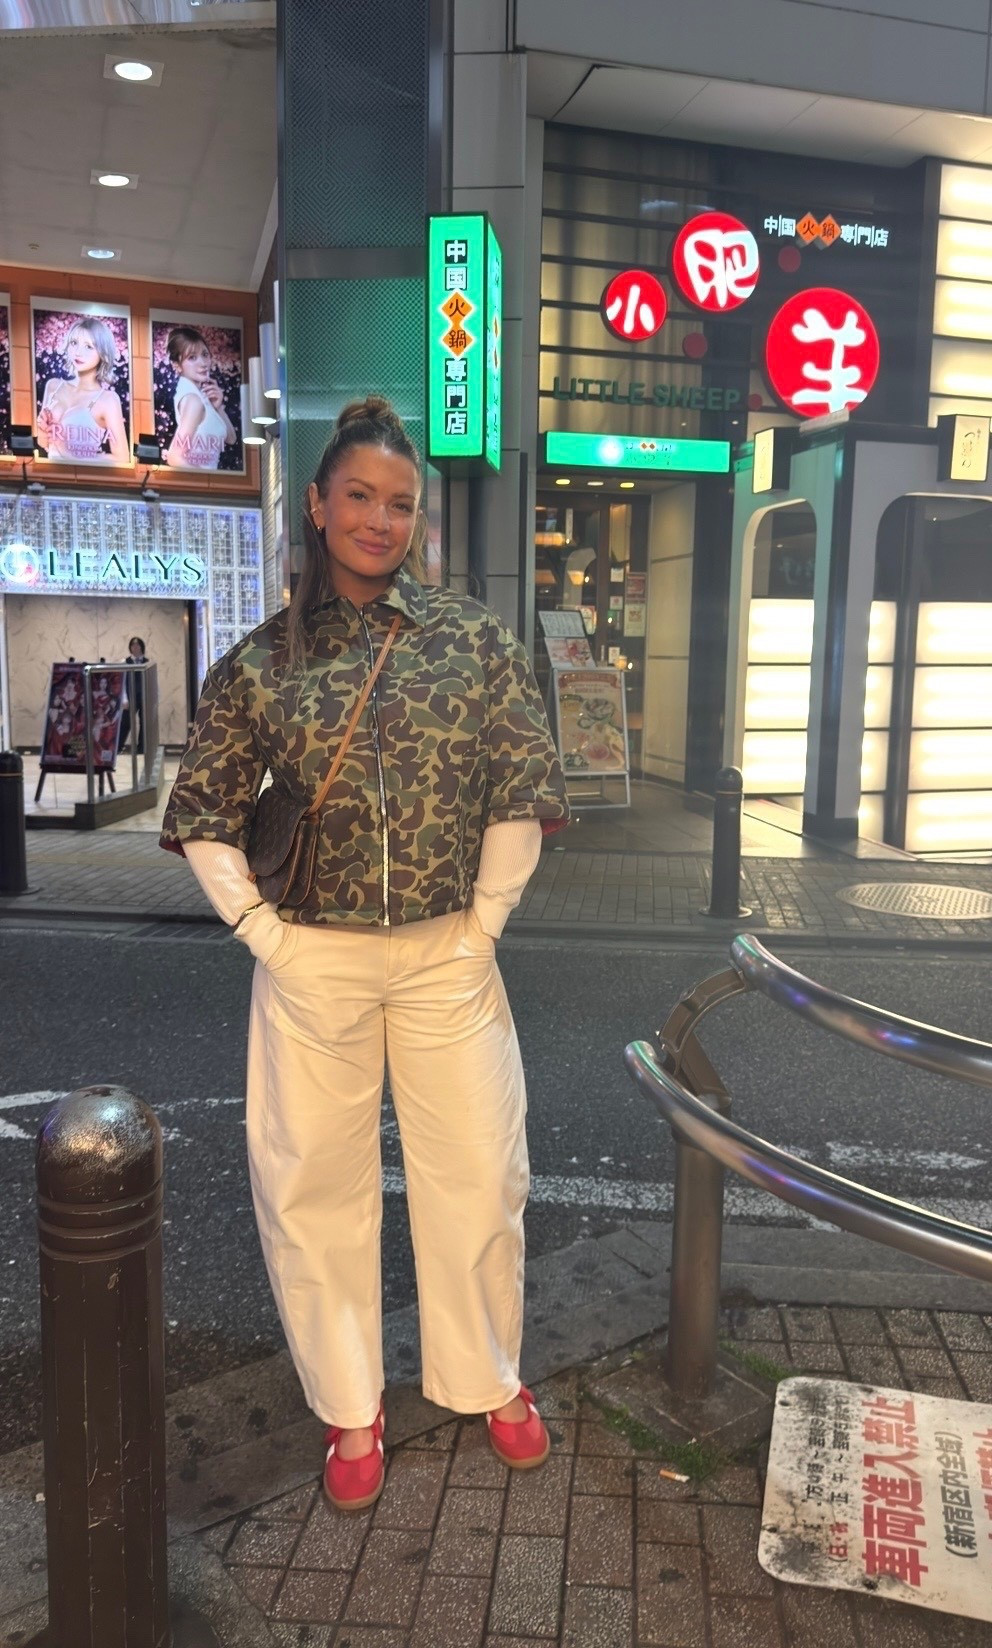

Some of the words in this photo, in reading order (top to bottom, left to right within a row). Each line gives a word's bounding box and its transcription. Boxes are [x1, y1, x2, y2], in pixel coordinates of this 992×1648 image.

[606, 284, 655, 334] 小
[684, 229, 759, 308] 肥
[791, 308, 868, 413] 羊
[552, 376, 646, 406] LITTLE
[653, 383, 741, 411] SHEEP
[52, 424, 117, 444] REINA
[174, 435, 226, 452] MARI
[47, 548, 206, 585] LEALYS
[861, 1396, 929, 1587] 車両進入禁止
